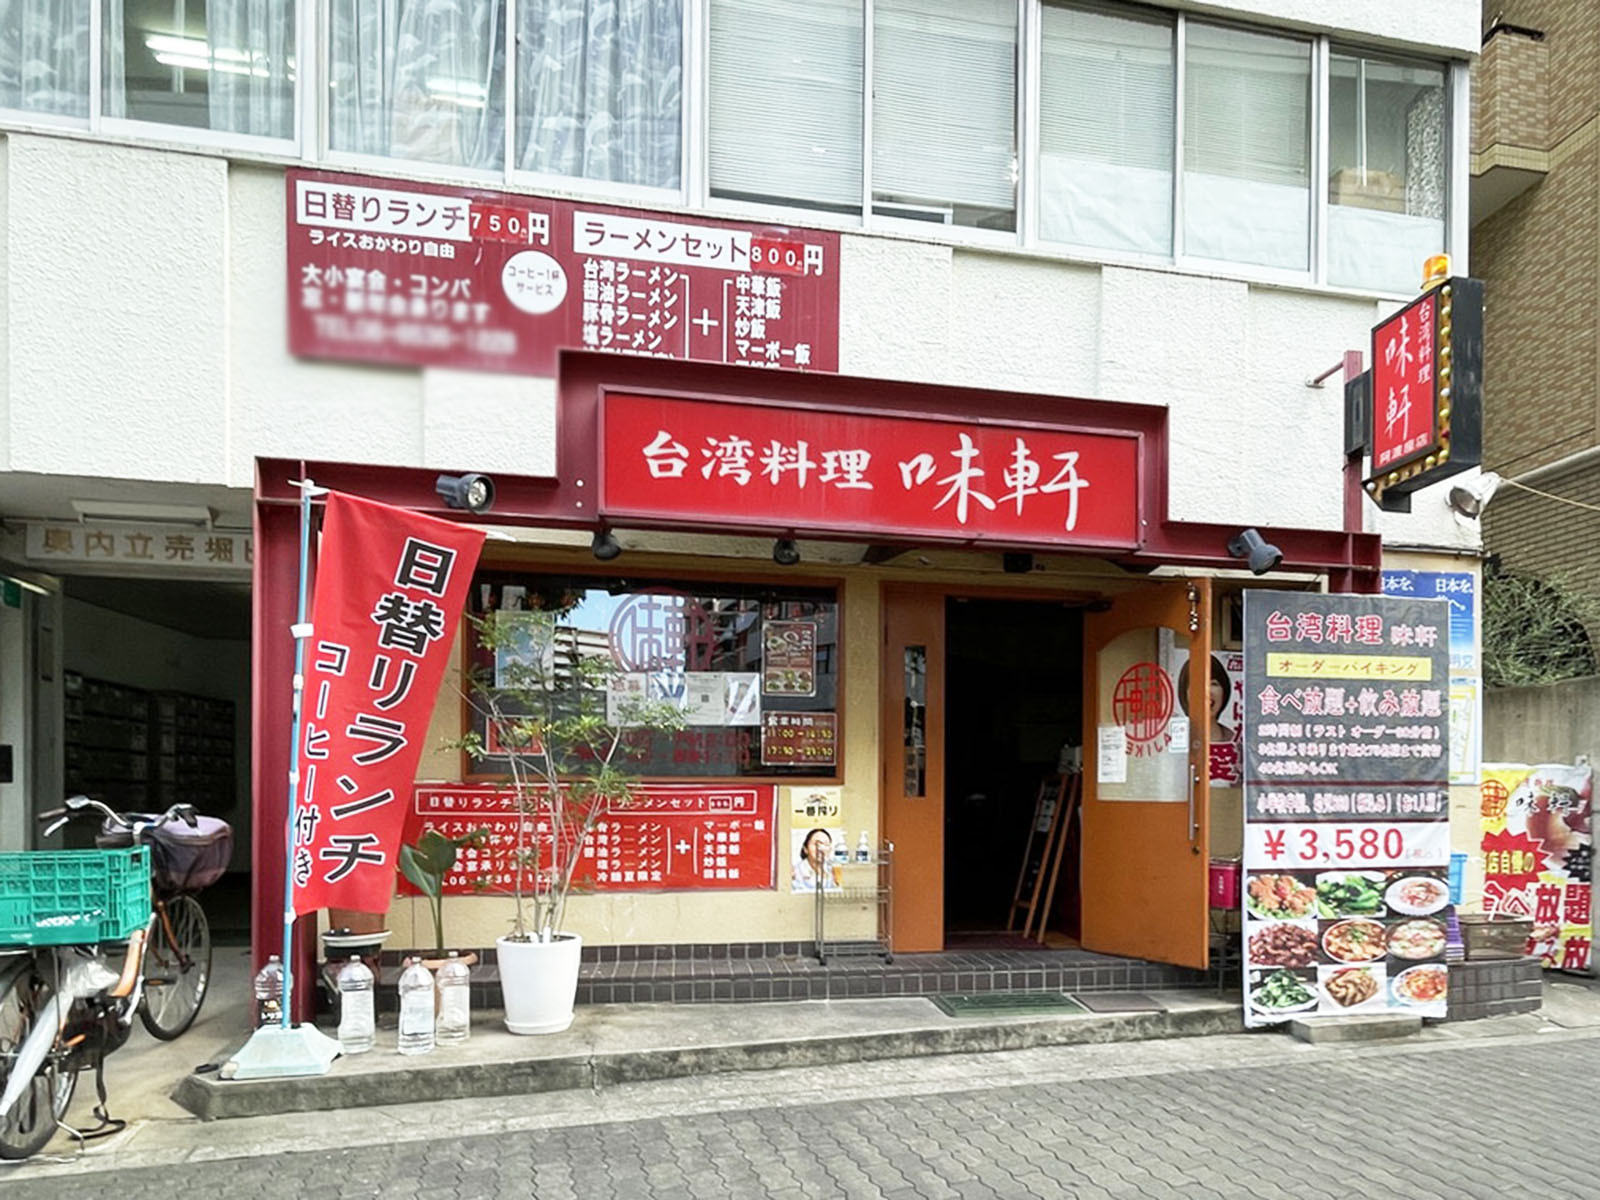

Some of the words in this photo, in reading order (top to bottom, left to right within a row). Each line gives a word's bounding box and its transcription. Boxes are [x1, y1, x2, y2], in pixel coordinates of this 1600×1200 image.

[308, 229, 456, 259] ライスおかわり自由
[585, 221, 747, 263] ラーメンセット
[583, 257, 678, 286] 台湾ラーメン
[735, 295, 781, 320] 天津飯
[1417, 301, 1432, 385] 台湾料理
[1384, 315, 1413, 441] 味軒
[642, 430, 873, 490] 台湾料理
[899, 433, 1089, 531] 味軒
[1381, 575, 1415, 592] 本を、
[1266, 610, 1384, 645] 台湾料理
[1278, 659, 1418, 677] オーダーバイキング
[293, 641, 350, 888] コーヒー付き
[429, 796, 512, 808] 日替りランチ
[794, 805, 838, 817] 一番搾り
[1264, 828, 1404, 863] ¥3,580
